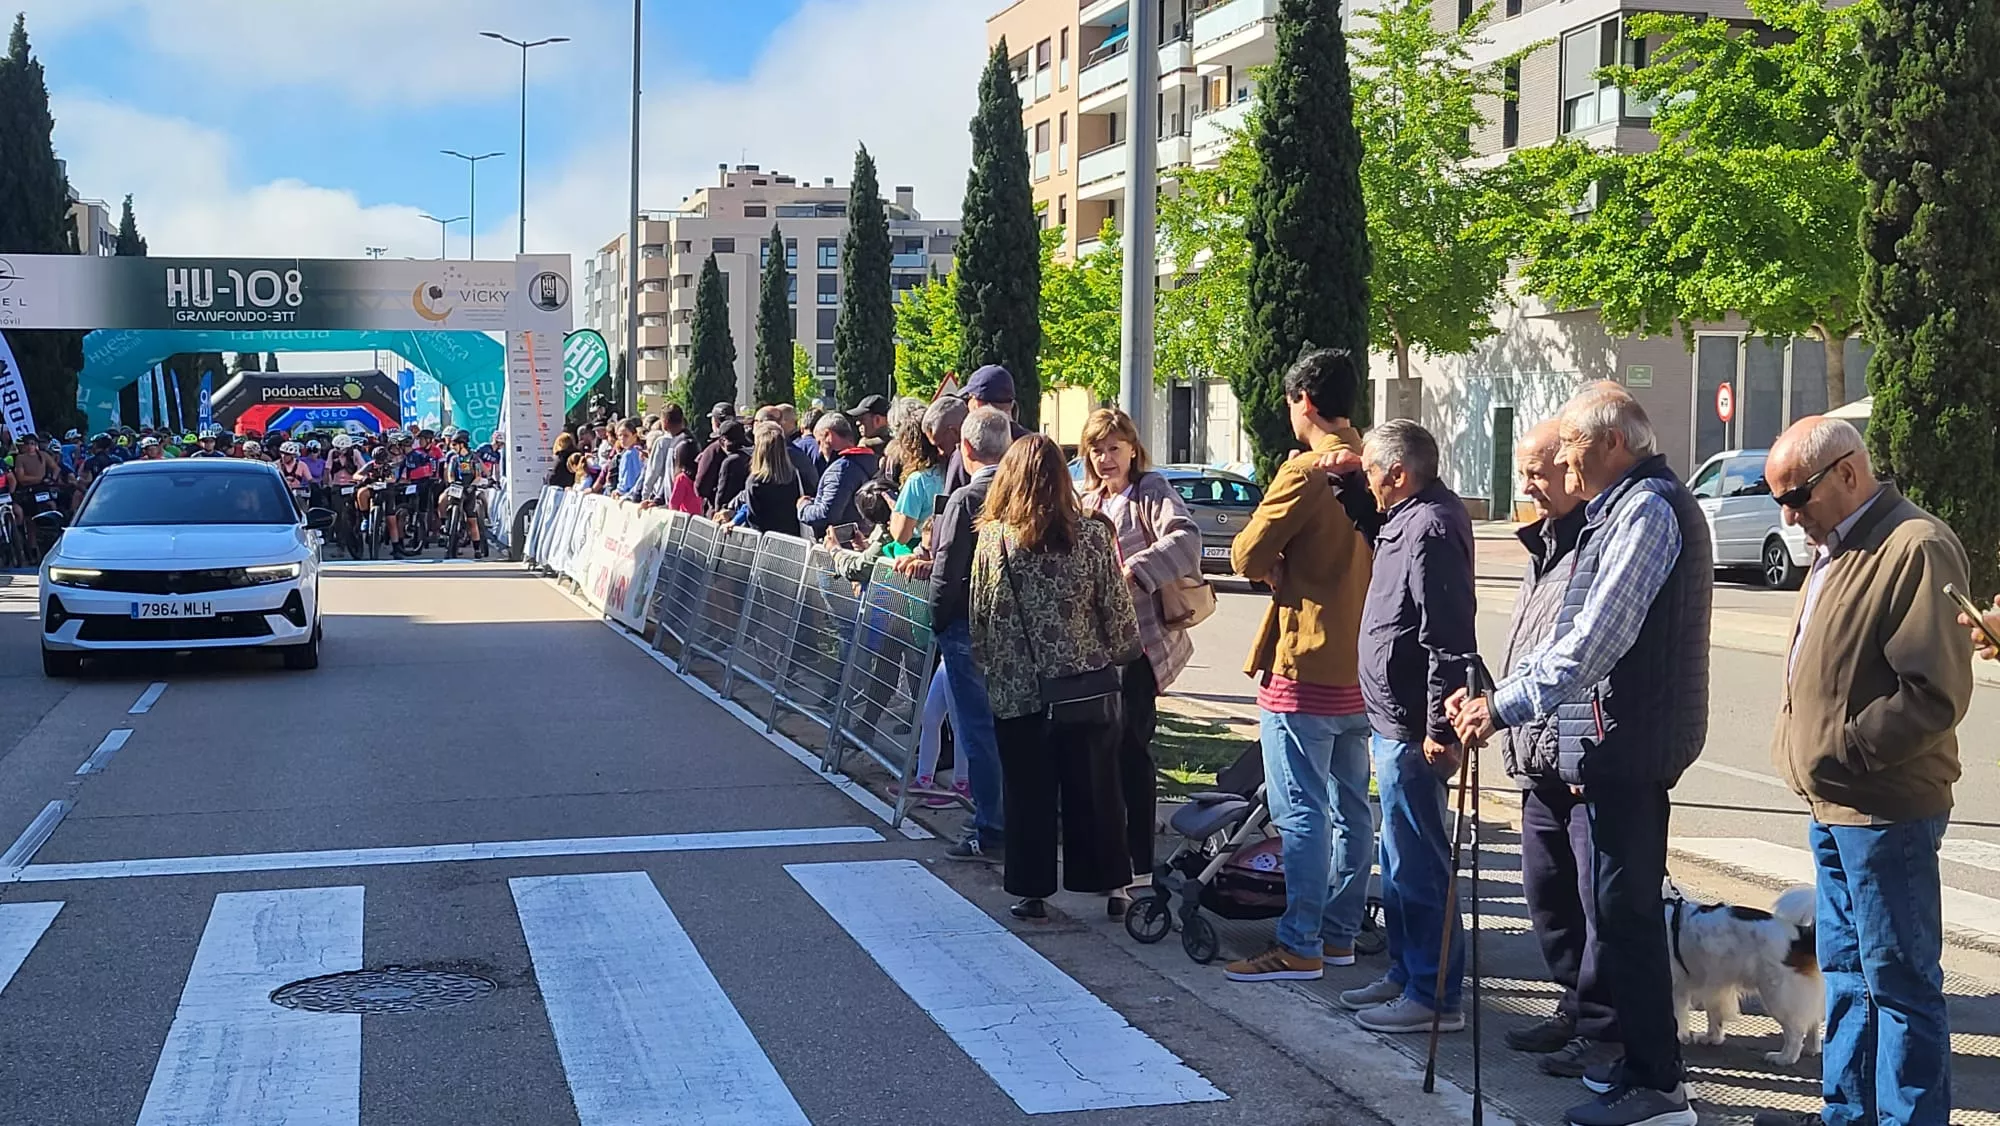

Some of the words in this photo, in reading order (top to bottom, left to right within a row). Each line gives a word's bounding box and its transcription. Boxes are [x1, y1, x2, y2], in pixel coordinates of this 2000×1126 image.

[167, 268, 303, 307] HU-108
[2, 297, 28, 307] EL
[563, 367, 587, 394] 08
[261, 384, 342, 401] podoactiva
[320, 409, 349, 418] GEO
[141, 602, 179, 617] 7964
[183, 601, 212, 616] MLH
